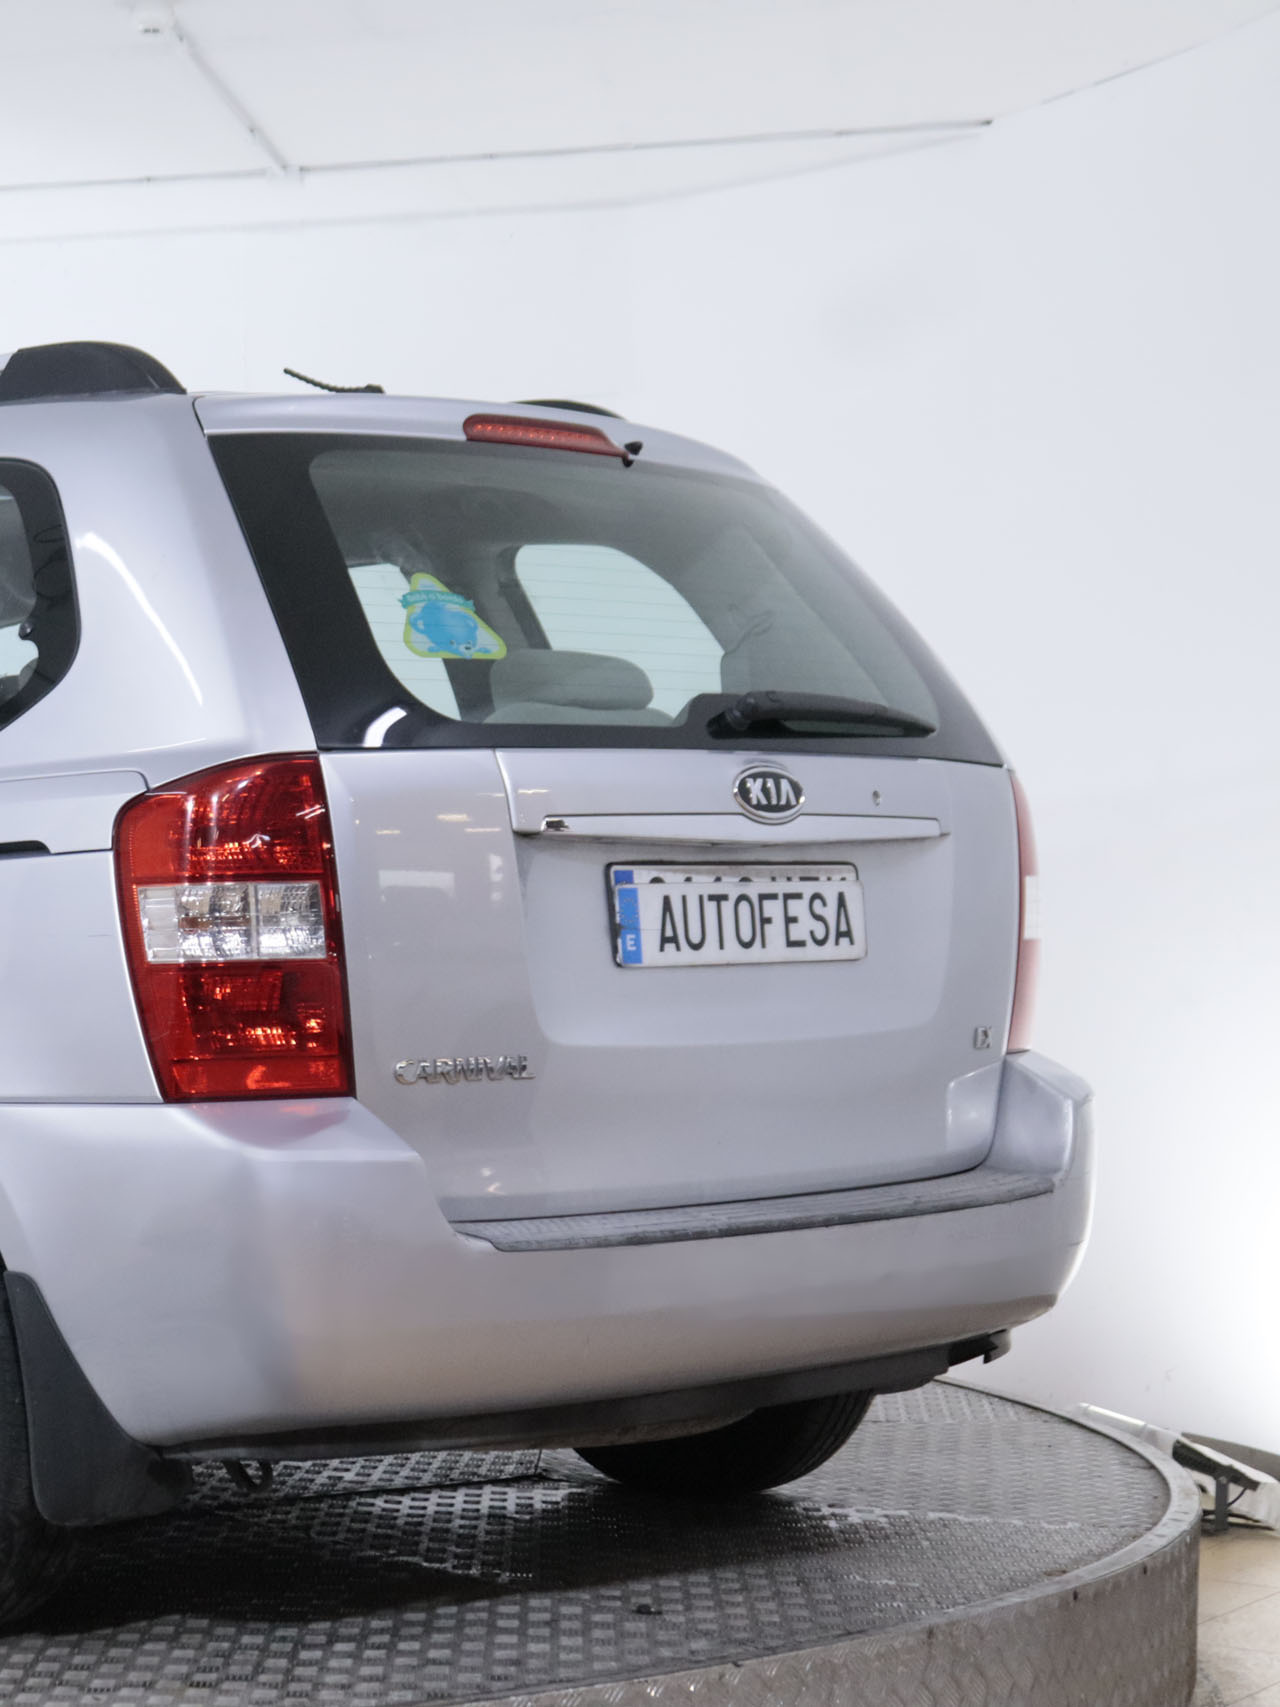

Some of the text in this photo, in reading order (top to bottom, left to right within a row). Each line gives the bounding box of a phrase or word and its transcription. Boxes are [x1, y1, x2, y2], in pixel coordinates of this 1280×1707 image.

[745, 777, 798, 805] KIA
[659, 892, 854, 953] AUTOFESA
[628, 936, 637, 951] E
[394, 1054, 536, 1086] CARNIVAL
